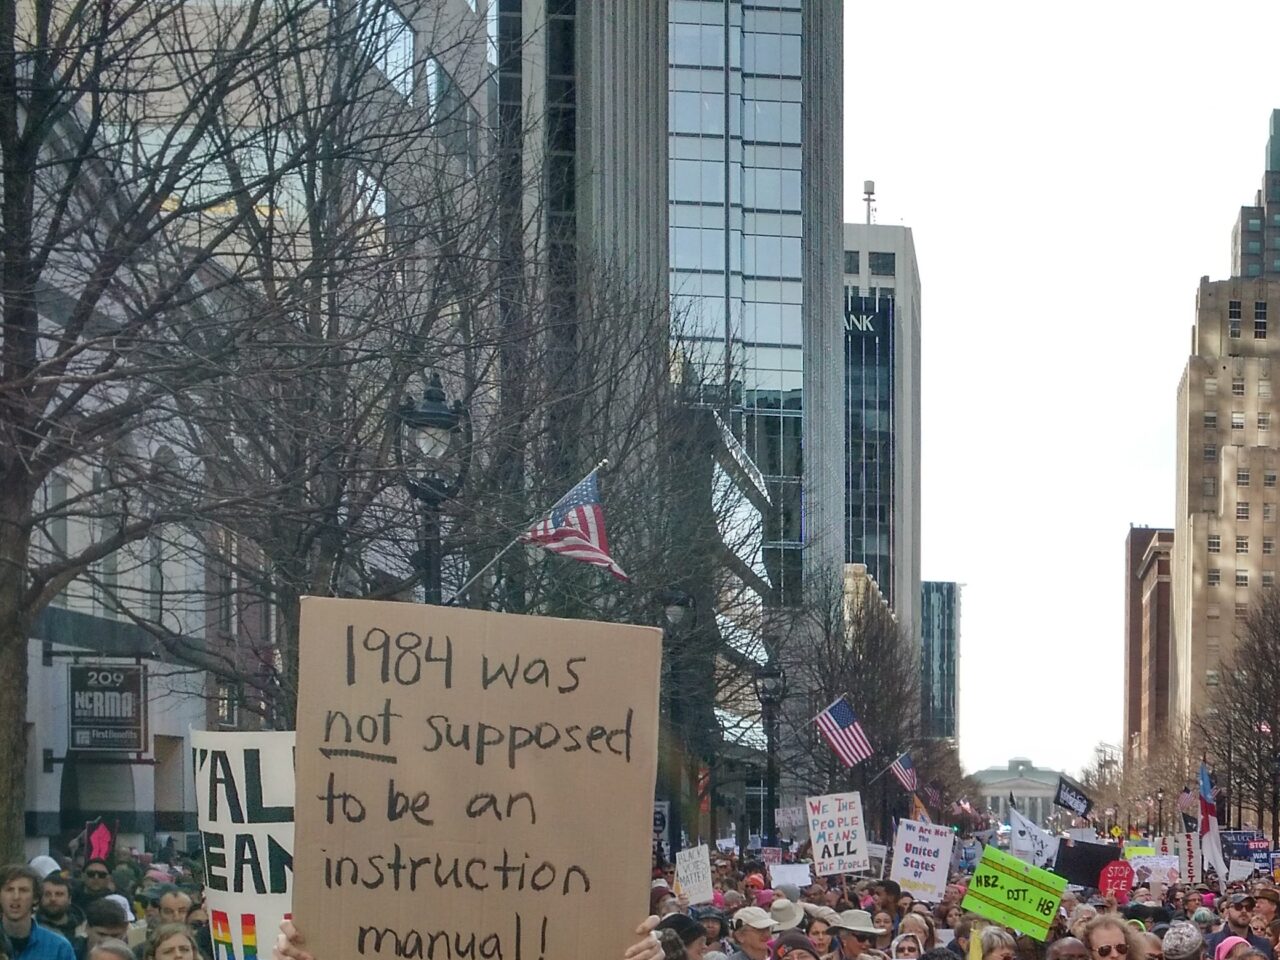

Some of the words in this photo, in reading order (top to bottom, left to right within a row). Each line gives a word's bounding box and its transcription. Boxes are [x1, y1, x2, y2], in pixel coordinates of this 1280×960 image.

[347, 625, 453, 689] 1984
[481, 653, 587, 694] was
[87, 671, 124, 687] 209
[323, 698, 403, 746] not
[423, 707, 634, 769] supposed
[316, 772, 367, 825] to
[387, 778, 435, 826] be
[465, 792, 537, 825] an
[811, 816, 859, 831] PEOPLE
[816, 830, 858, 844] MEANS
[821, 841, 857, 859] ALL
[904, 843, 940, 858] United
[903, 857, 936, 872] States
[1185, 834, 1196, 884] RESPECT
[322, 842, 592, 896] instruction
[1106, 866, 1131, 878] STOP
[1107, 880, 1128, 891] ICE
[976, 875, 999, 888] HB2
[1007, 889, 1028, 901] DJT
[1036, 900, 1055, 917] H8
